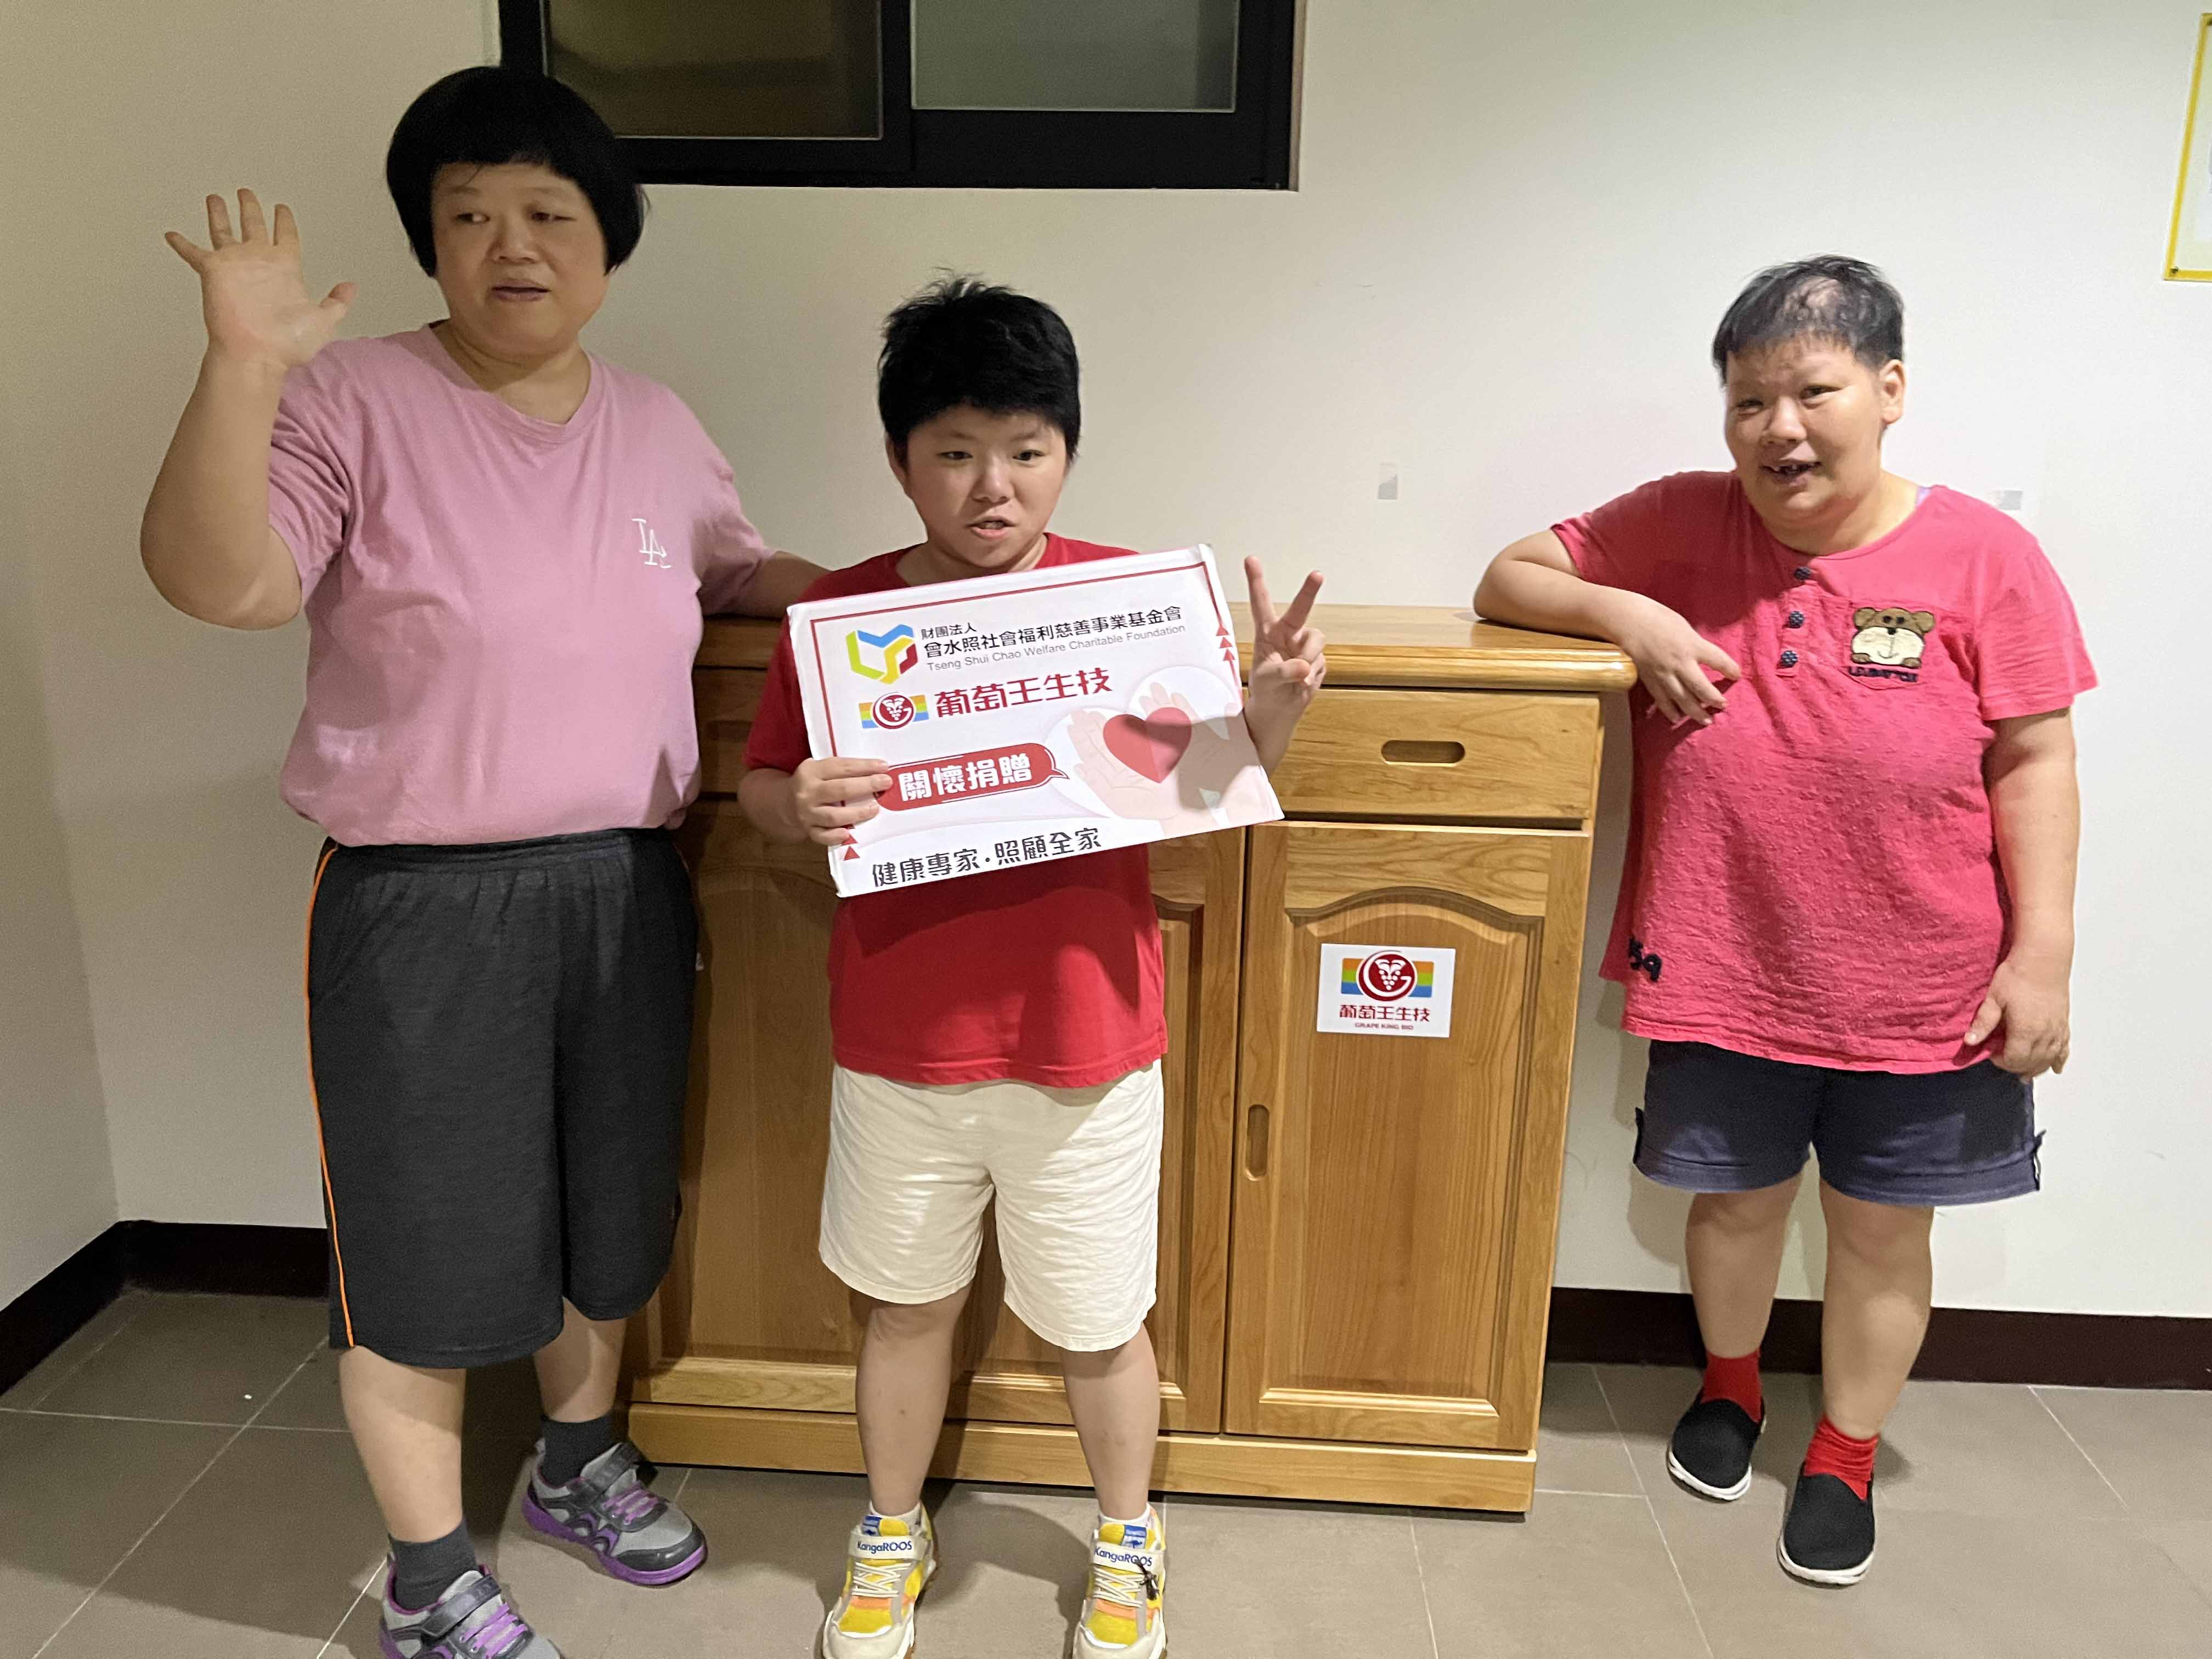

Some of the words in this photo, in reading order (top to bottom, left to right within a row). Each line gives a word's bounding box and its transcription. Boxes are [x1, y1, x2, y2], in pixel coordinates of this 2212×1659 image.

[921, 622, 977, 640] 財團法人
[927, 660, 961, 671] Tseng
[964, 653, 989, 665] Shui
[992, 650, 1022, 661] Chao
[1024, 644, 1066, 656] Welfare
[1069, 634, 1124, 650] Charitable
[1126, 624, 1186, 641] Foundation
[934, 667, 1113, 718] 葡萄王生技
[898, 753, 1032, 802] 關懷捐贈
[1339, 1004, 1431, 1022] 葡萄王生技
[857, 1540, 912, 1554] KangaROOS
[1094, 1547, 1152, 1567] KangaROOS
